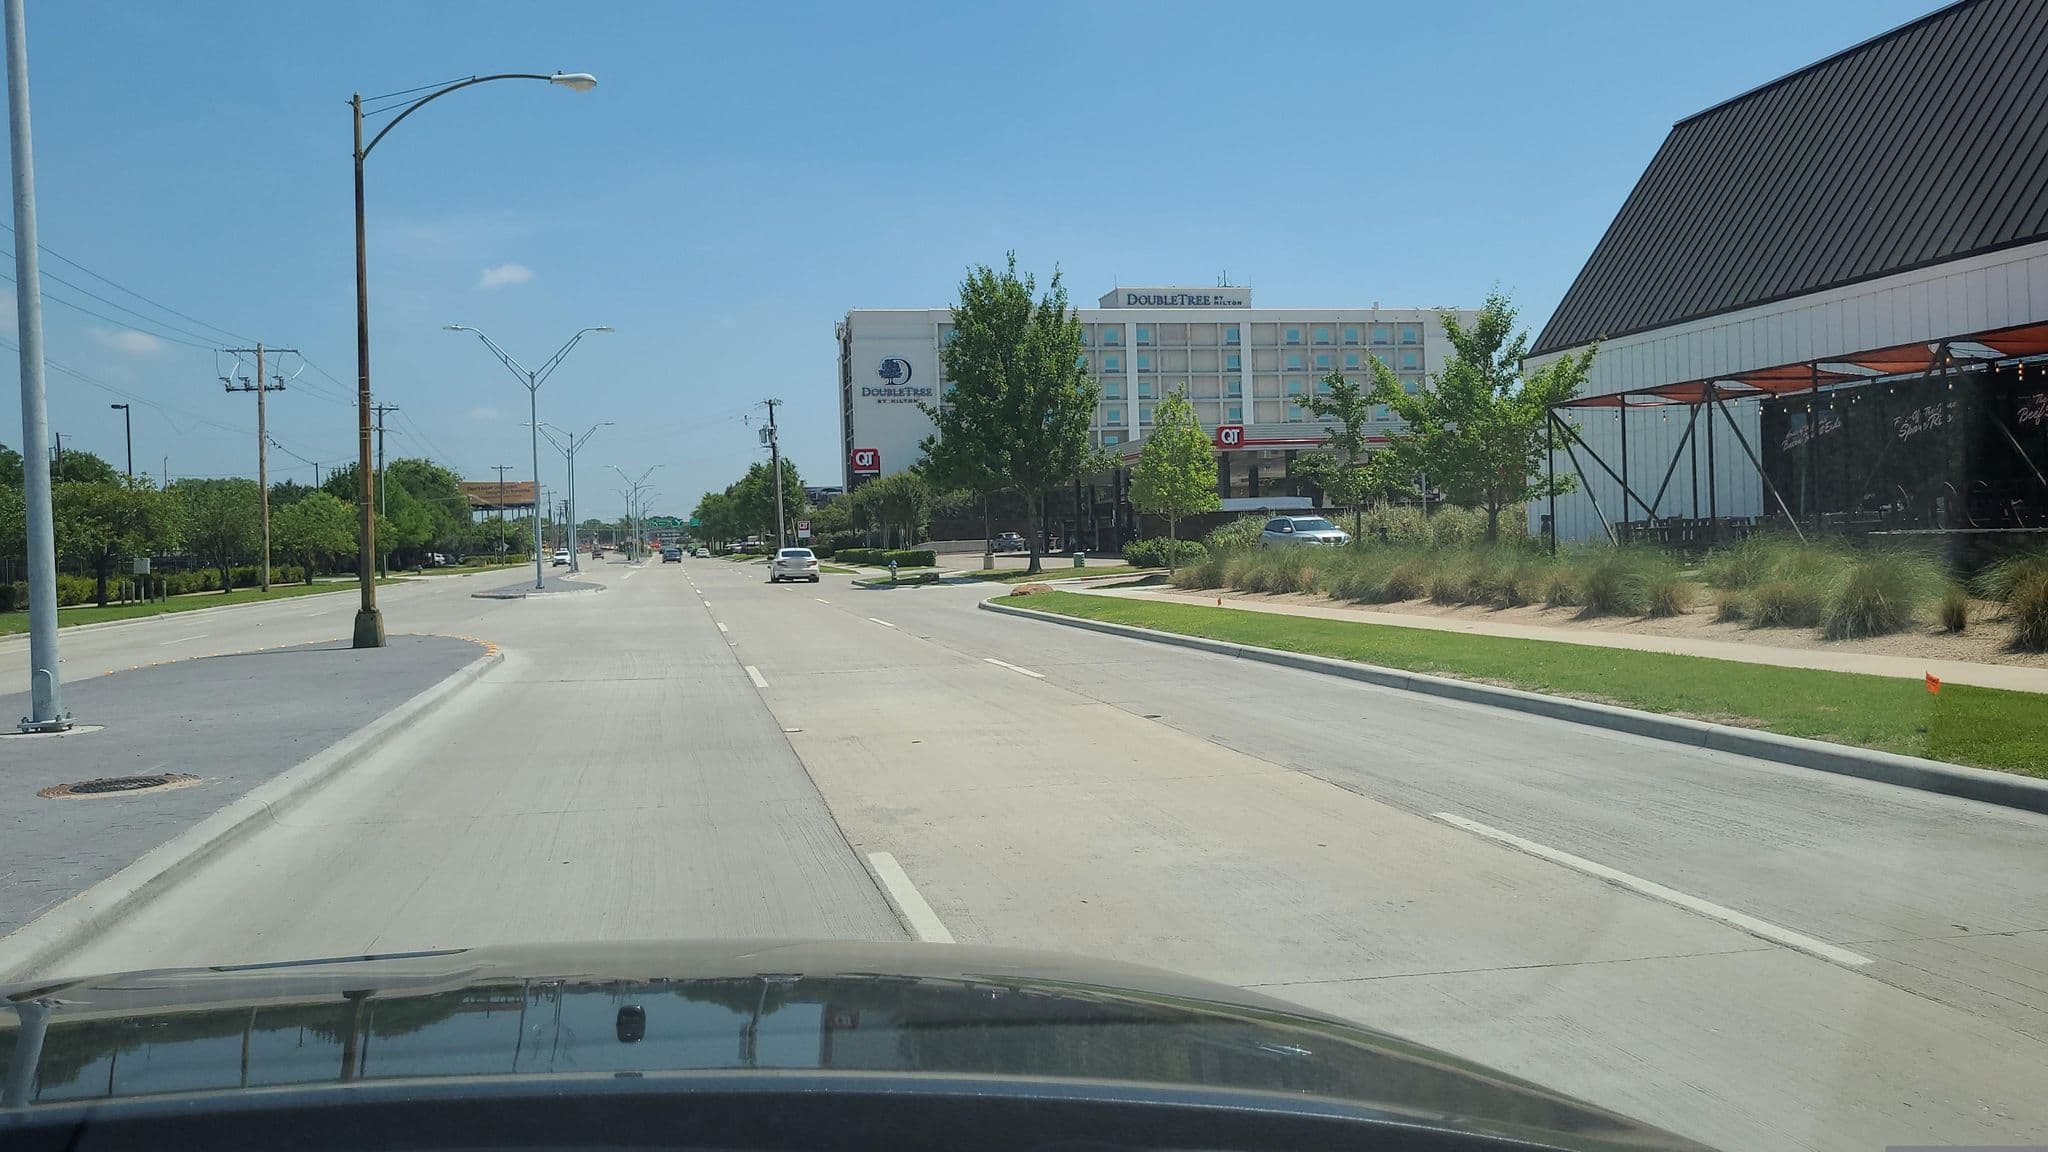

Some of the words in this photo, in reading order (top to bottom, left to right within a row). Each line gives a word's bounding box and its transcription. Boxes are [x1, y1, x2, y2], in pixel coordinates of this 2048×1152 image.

[1928, 413, 1954, 429] Ris
[2017, 403, 2045, 425] Beef
[1221, 428, 1240, 445] QT
[855, 451, 874, 467] QT
